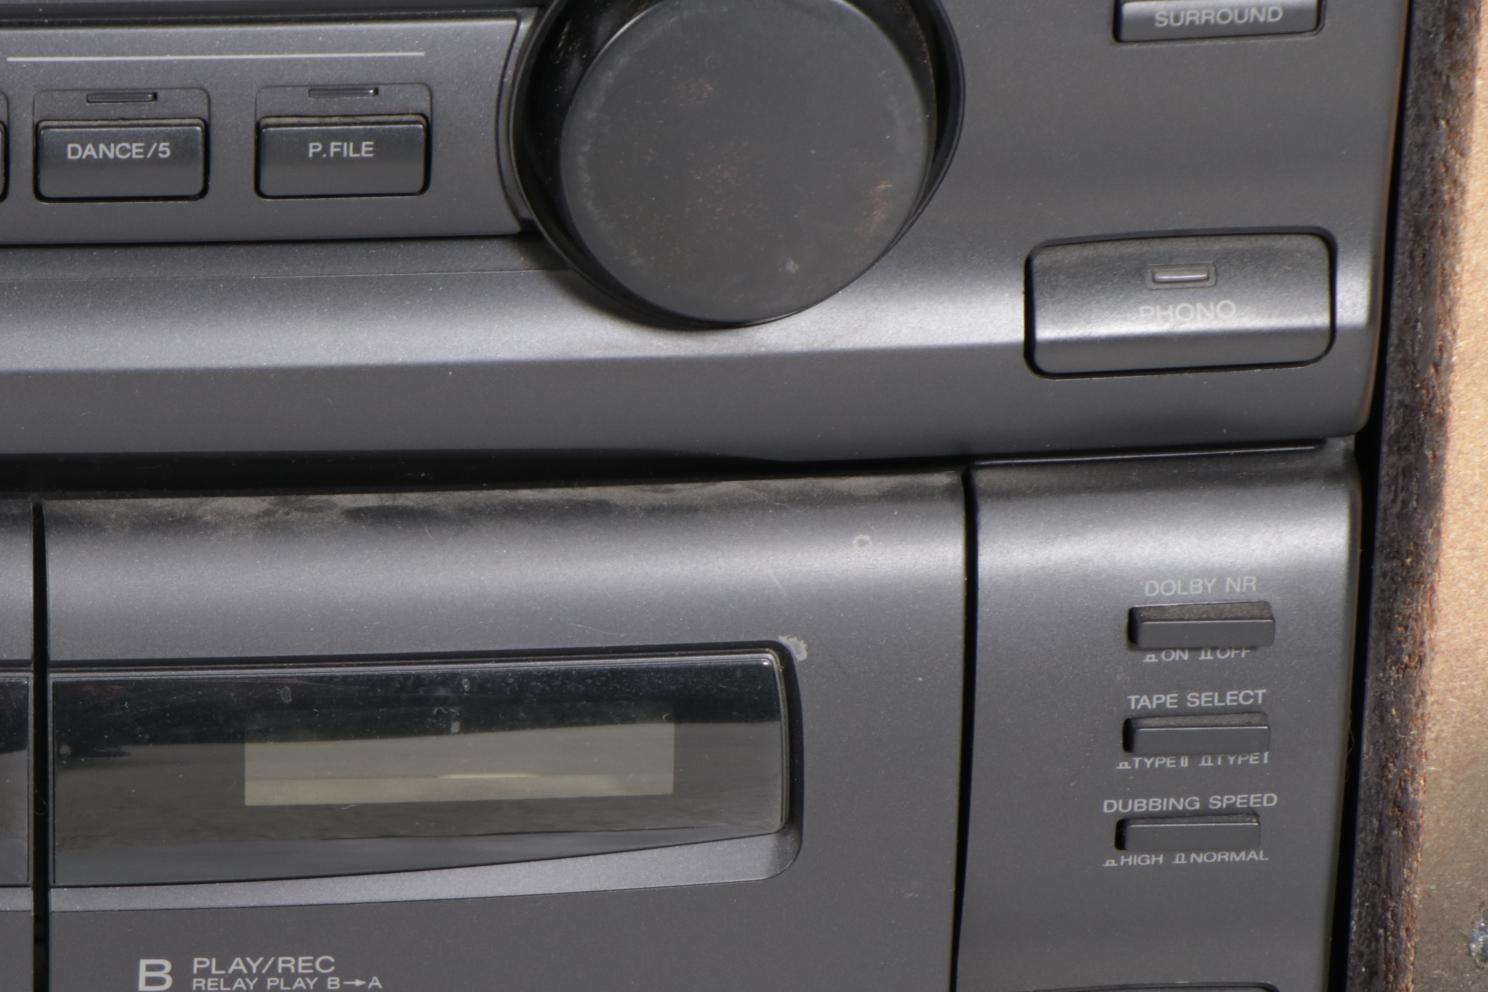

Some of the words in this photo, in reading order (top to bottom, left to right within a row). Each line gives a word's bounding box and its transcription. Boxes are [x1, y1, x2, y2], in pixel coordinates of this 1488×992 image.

[1154, 6, 1283, 28] SURROUND
[66, 142, 171, 160] DANCE/5
[307, 141, 375, 158] P.FILE
[1139, 301, 1236, 322] PHONO
[1144, 579, 1215, 597] DOLBY
[1226, 576, 1257, 593] NR
[1162, 650, 1189, 661] ON
[1128, 694, 1179, 710] TAPE
[1186, 689, 1267, 708] SELECT
[1103, 797, 1200, 813] DUBBING
[1209, 793, 1278, 809] SPEED
[1120, 854, 1163, 866] HIGH
[1190, 849, 1269, 863] NORMAL
[138, 958, 173, 991] B
[193, 956, 336, 974] PLAY/REC
[192, 977, 258, 991] RELAY
[267, 977, 318, 990] PLAY
